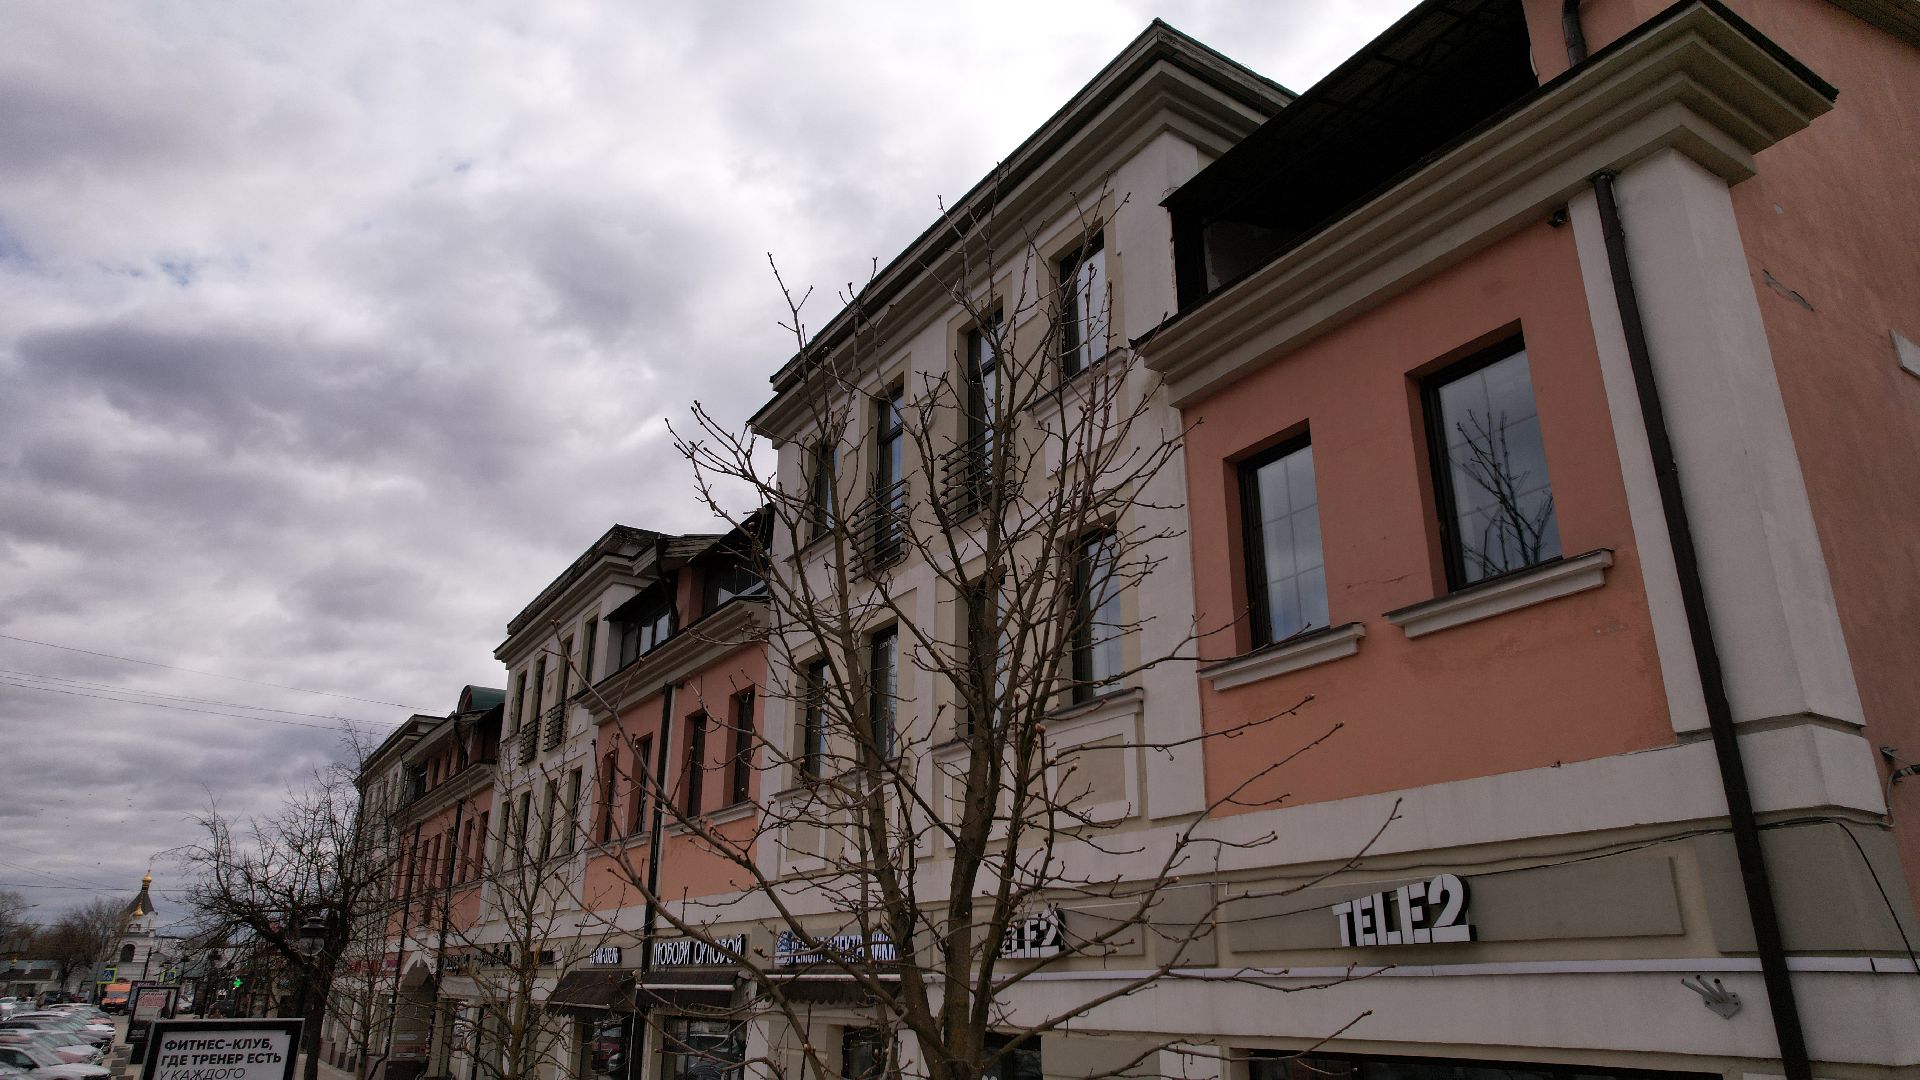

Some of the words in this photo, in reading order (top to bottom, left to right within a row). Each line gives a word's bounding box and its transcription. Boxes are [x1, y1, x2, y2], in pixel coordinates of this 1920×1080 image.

[1332, 874, 1473, 947] TELE2
[998, 909, 1063, 959] ELE2
[652, 941, 690, 965] ЛЮБОВИ
[164, 1037, 273, 1051] ФИТНЕС-КЛУБ,
[161, 1054, 188, 1067] ГДЕ
[191, 1053, 244, 1065] ТРЕНЕР
[247, 1052, 282, 1064] ЕСТЬ
[171, 1067, 246, 1080] КАЖДОГО
